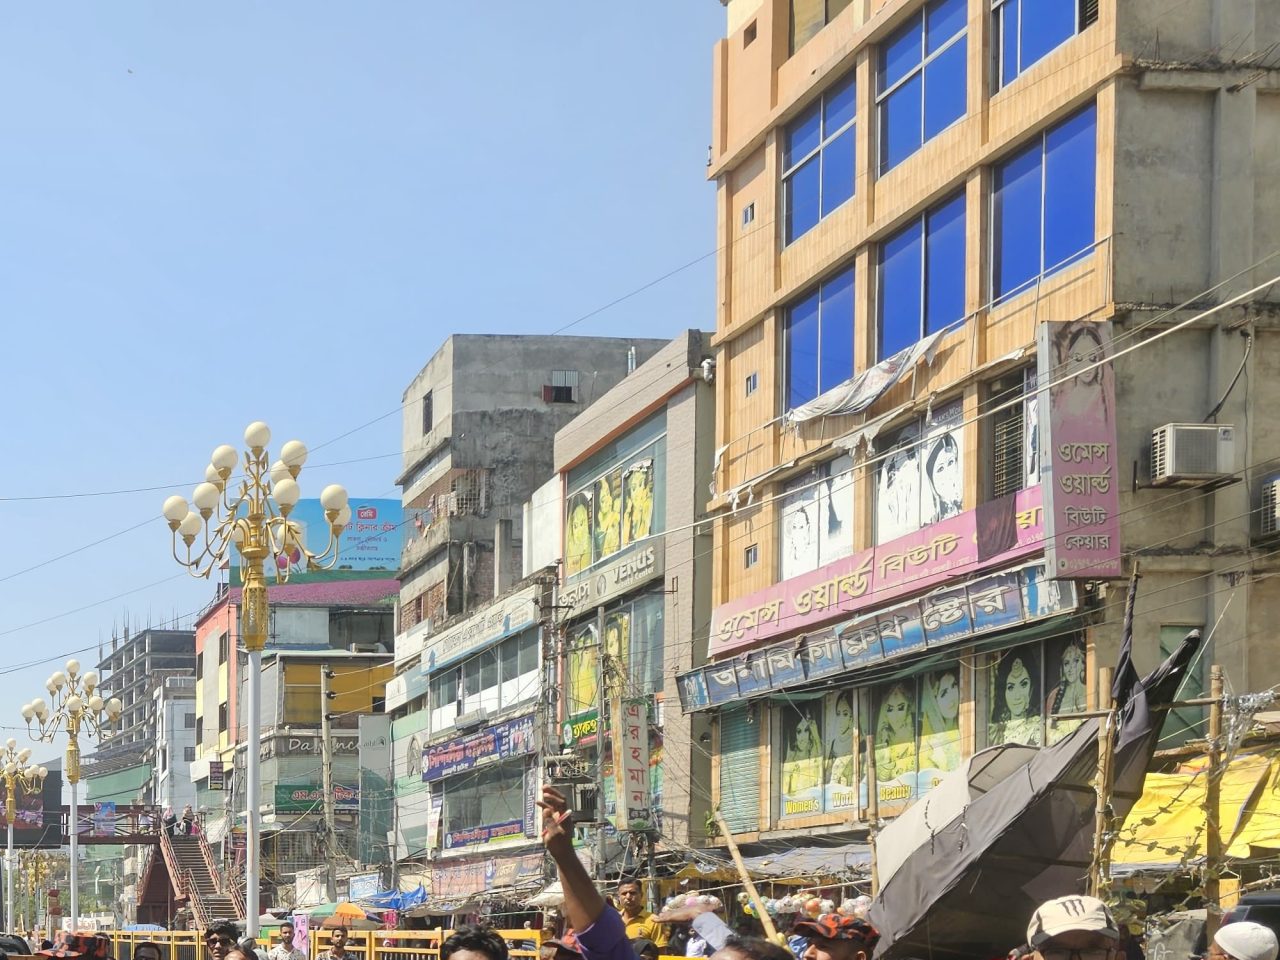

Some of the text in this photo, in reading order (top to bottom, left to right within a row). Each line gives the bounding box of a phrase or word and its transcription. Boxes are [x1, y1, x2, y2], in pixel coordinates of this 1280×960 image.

[1058, 441, 1110, 464] ওমেন্স
[1059, 466, 1112, 495] ওয়ার্ল্ড
[1064, 505, 1109, 527] বিউটি
[1064, 534, 1111, 551] কেয়ার
[612, 546, 656, 585] VENUS
[718, 598, 784, 643] ওমেন্স
[792, 555, 874, 617] ওয়ার্ল্ড
[879, 533, 963, 580] বিউটি
[785, 791, 855, 815] Women's Worl
[880, 785, 912, 801] Beauty
